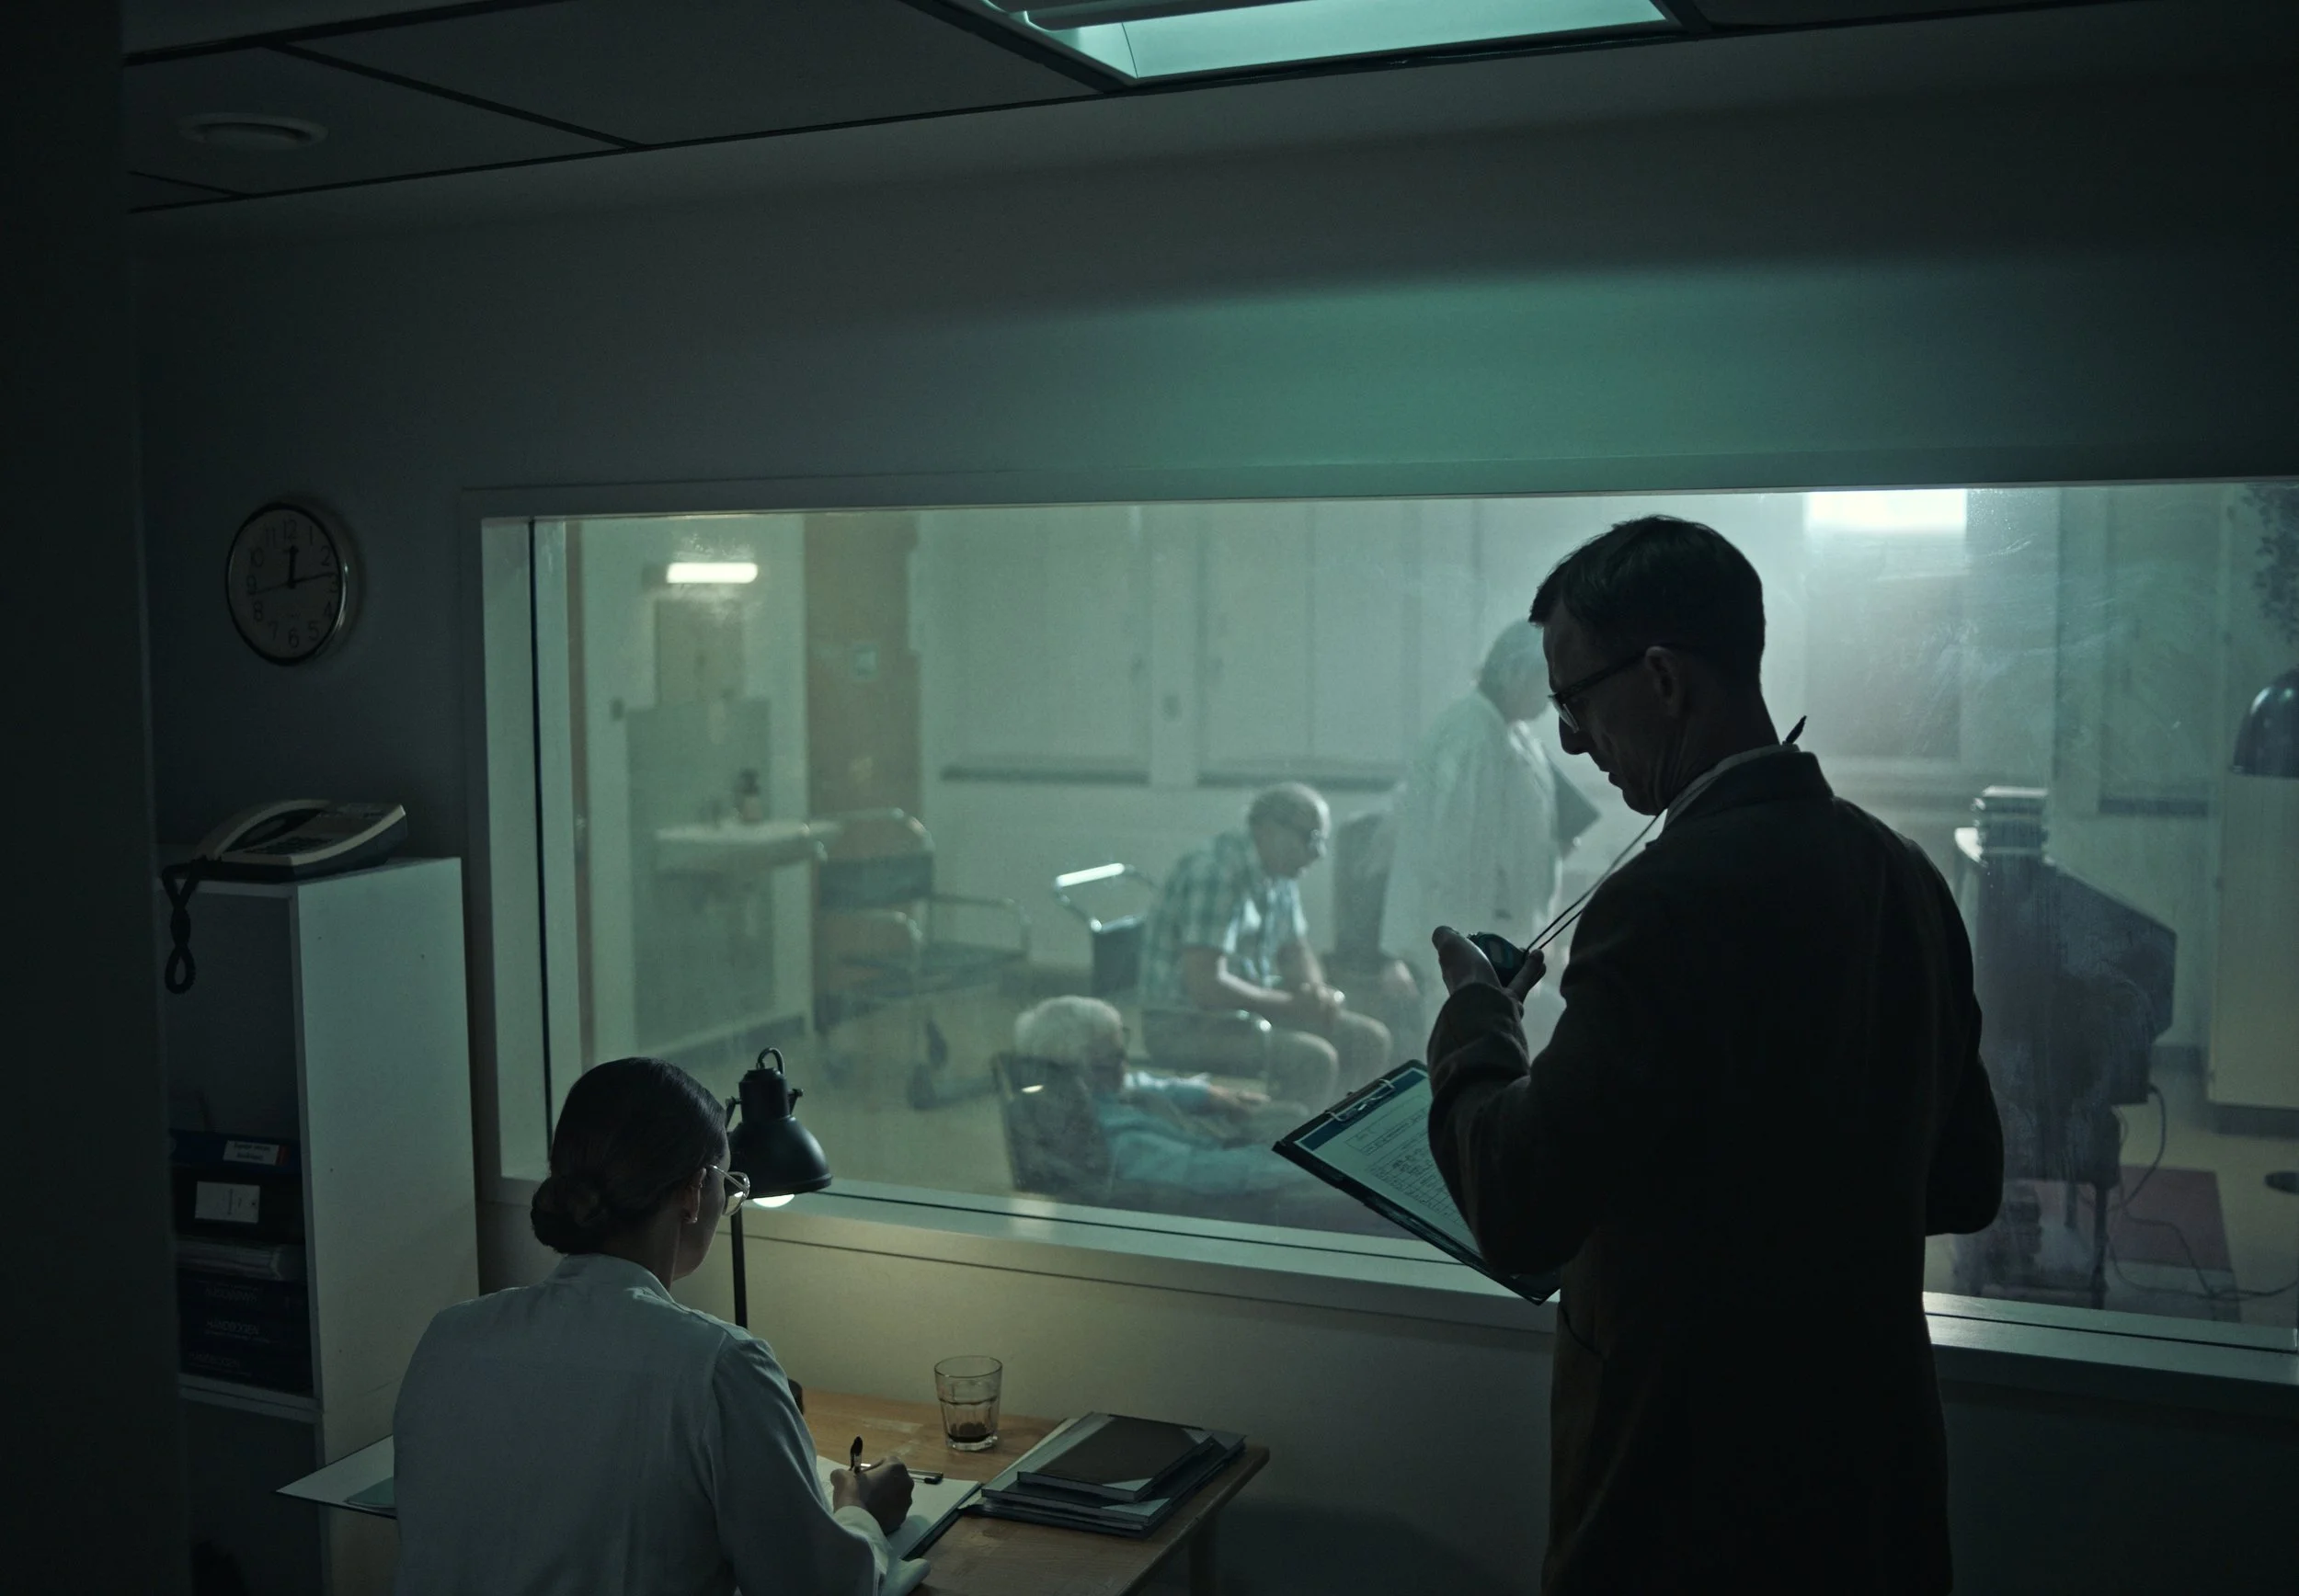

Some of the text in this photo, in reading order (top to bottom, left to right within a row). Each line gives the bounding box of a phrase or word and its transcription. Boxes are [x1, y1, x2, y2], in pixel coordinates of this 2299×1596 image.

[282, 519, 297, 540] 12
[249, 547, 264, 568] 10
[320, 545, 331, 566] 2
[253, 600, 264, 622] 8
[322, 600, 335, 619] 4
[268, 621, 280, 641] 7
[288, 627, 300, 649] 6
[308, 621, 319, 641] 5
